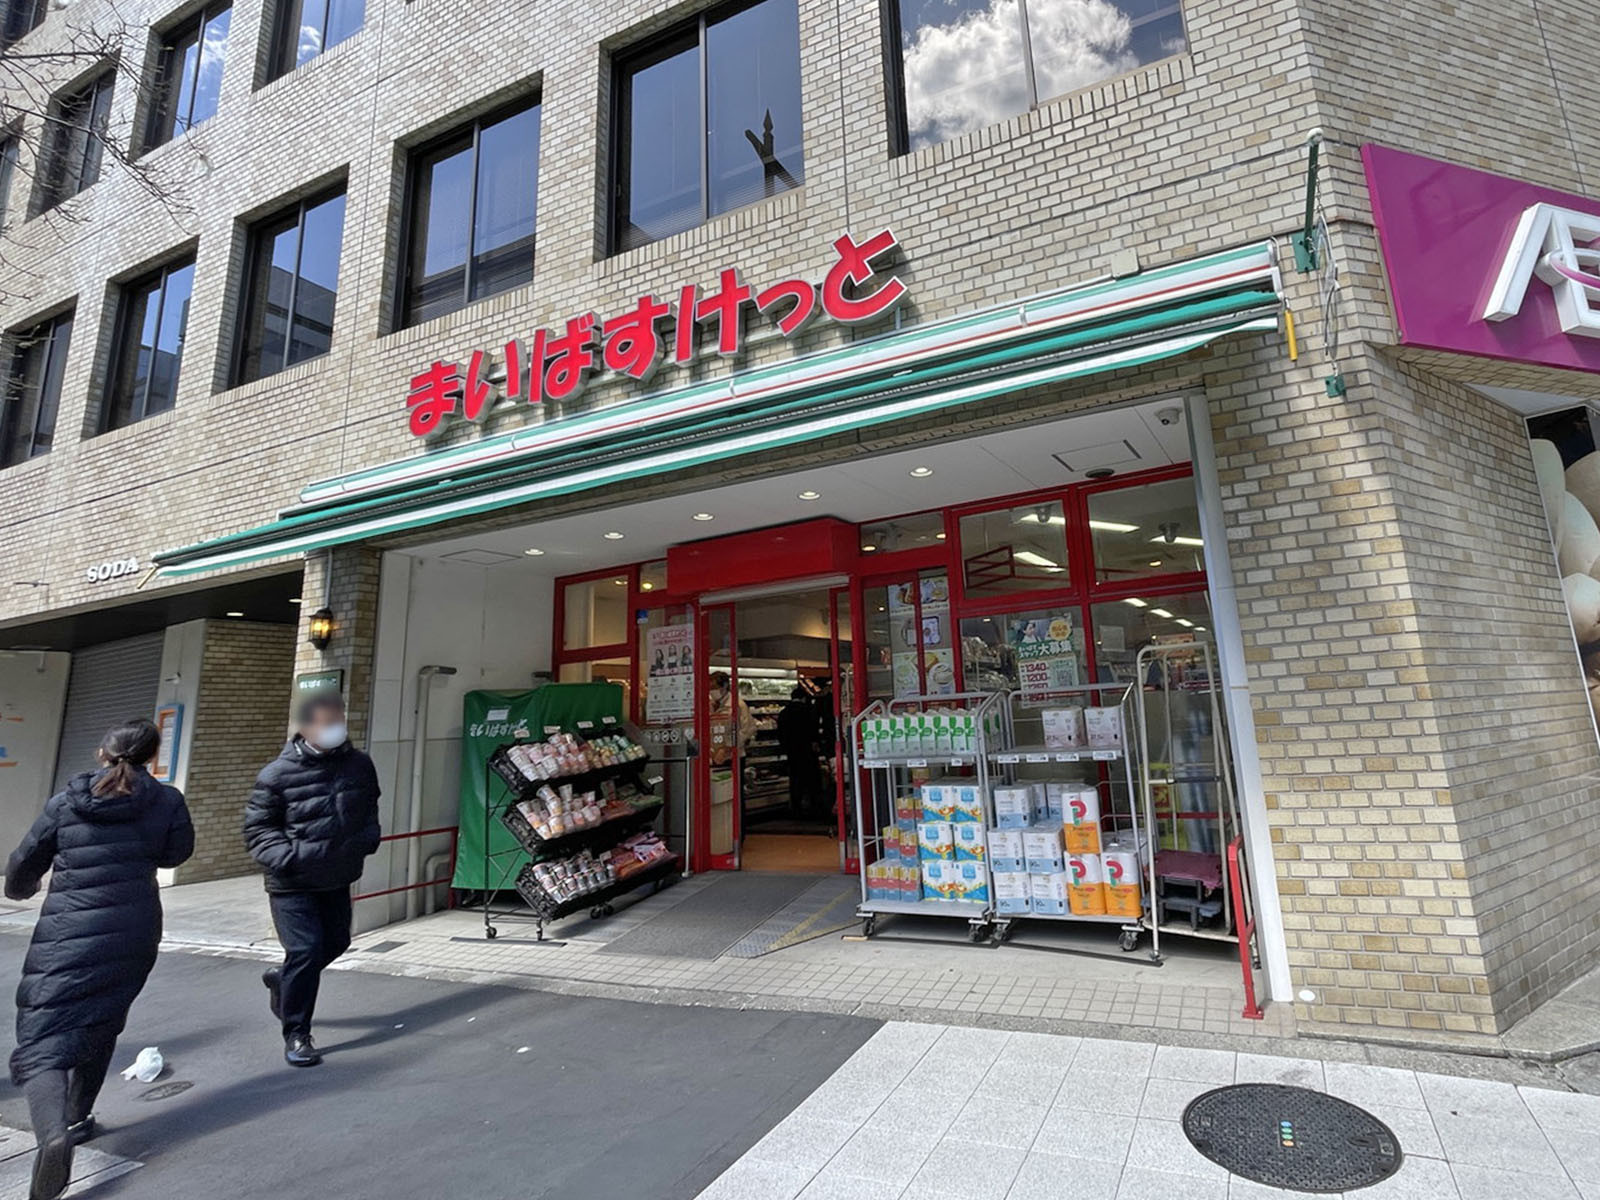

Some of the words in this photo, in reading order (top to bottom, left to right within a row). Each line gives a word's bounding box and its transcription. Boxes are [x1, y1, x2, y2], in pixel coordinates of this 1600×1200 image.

[406, 227, 908, 438] まいばすけっと
[87, 557, 140, 583] SODA
